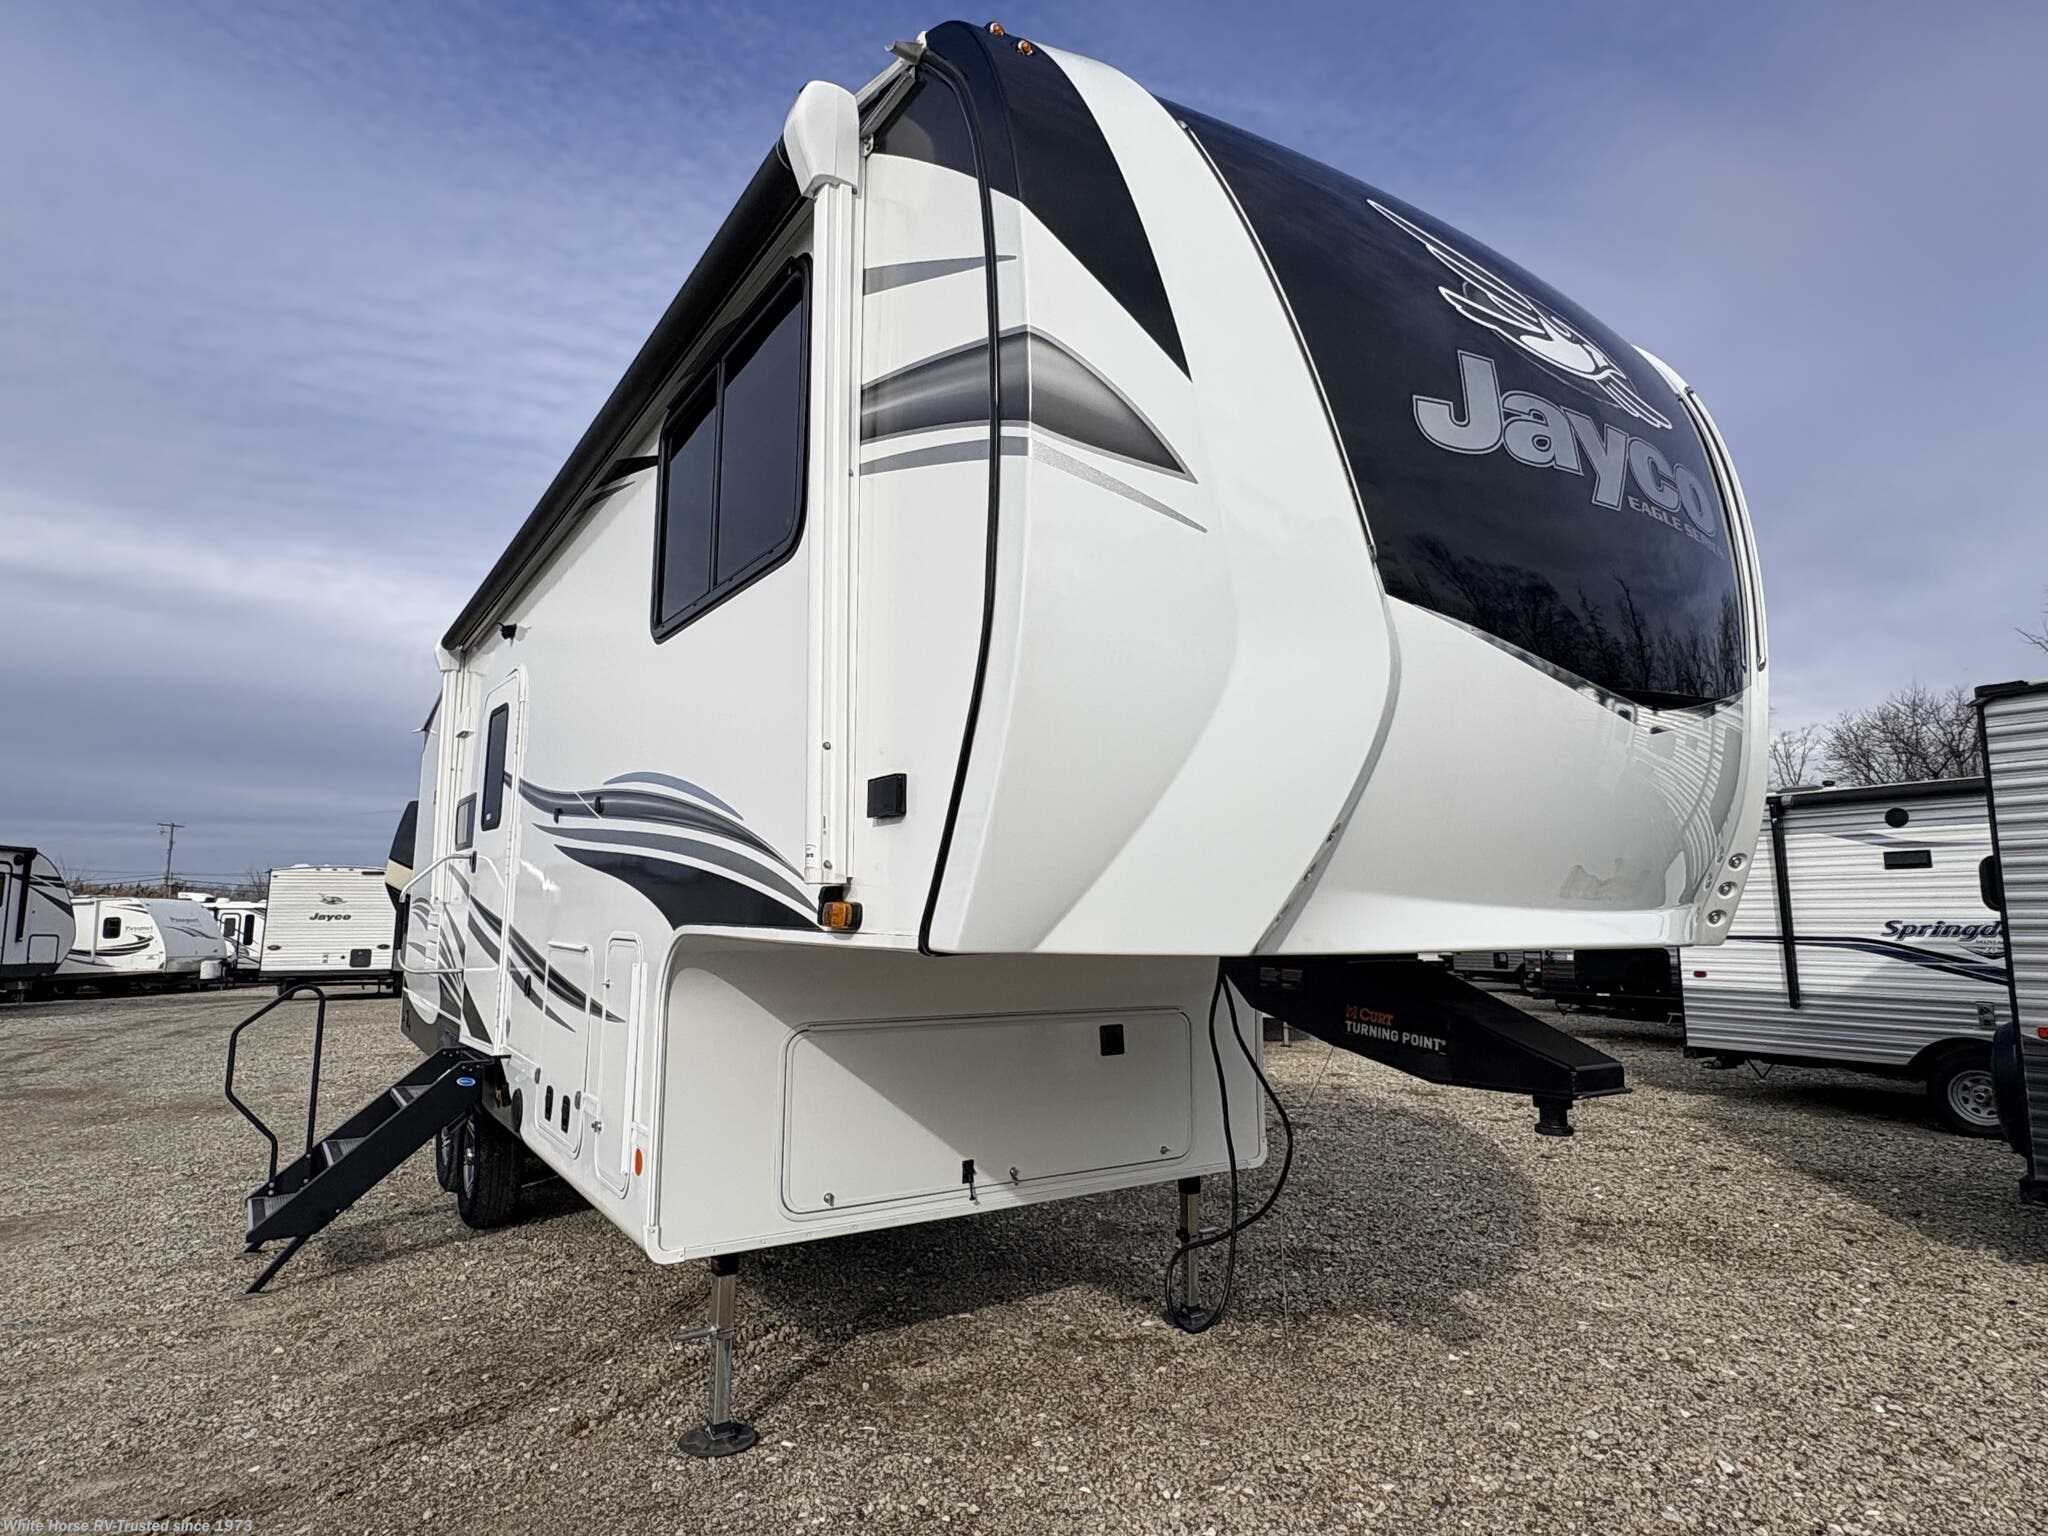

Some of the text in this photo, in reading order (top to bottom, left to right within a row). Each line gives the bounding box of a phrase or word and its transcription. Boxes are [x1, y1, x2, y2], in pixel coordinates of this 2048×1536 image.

[1412, 349, 1717, 538] Jayco
[1627, 495, 1684, 532] EAGLE
[308, 912, 353, 922] Jayco
[1880, 920, 2006, 942] Springd
[1345, 1020, 1400, 1042] TURNING
